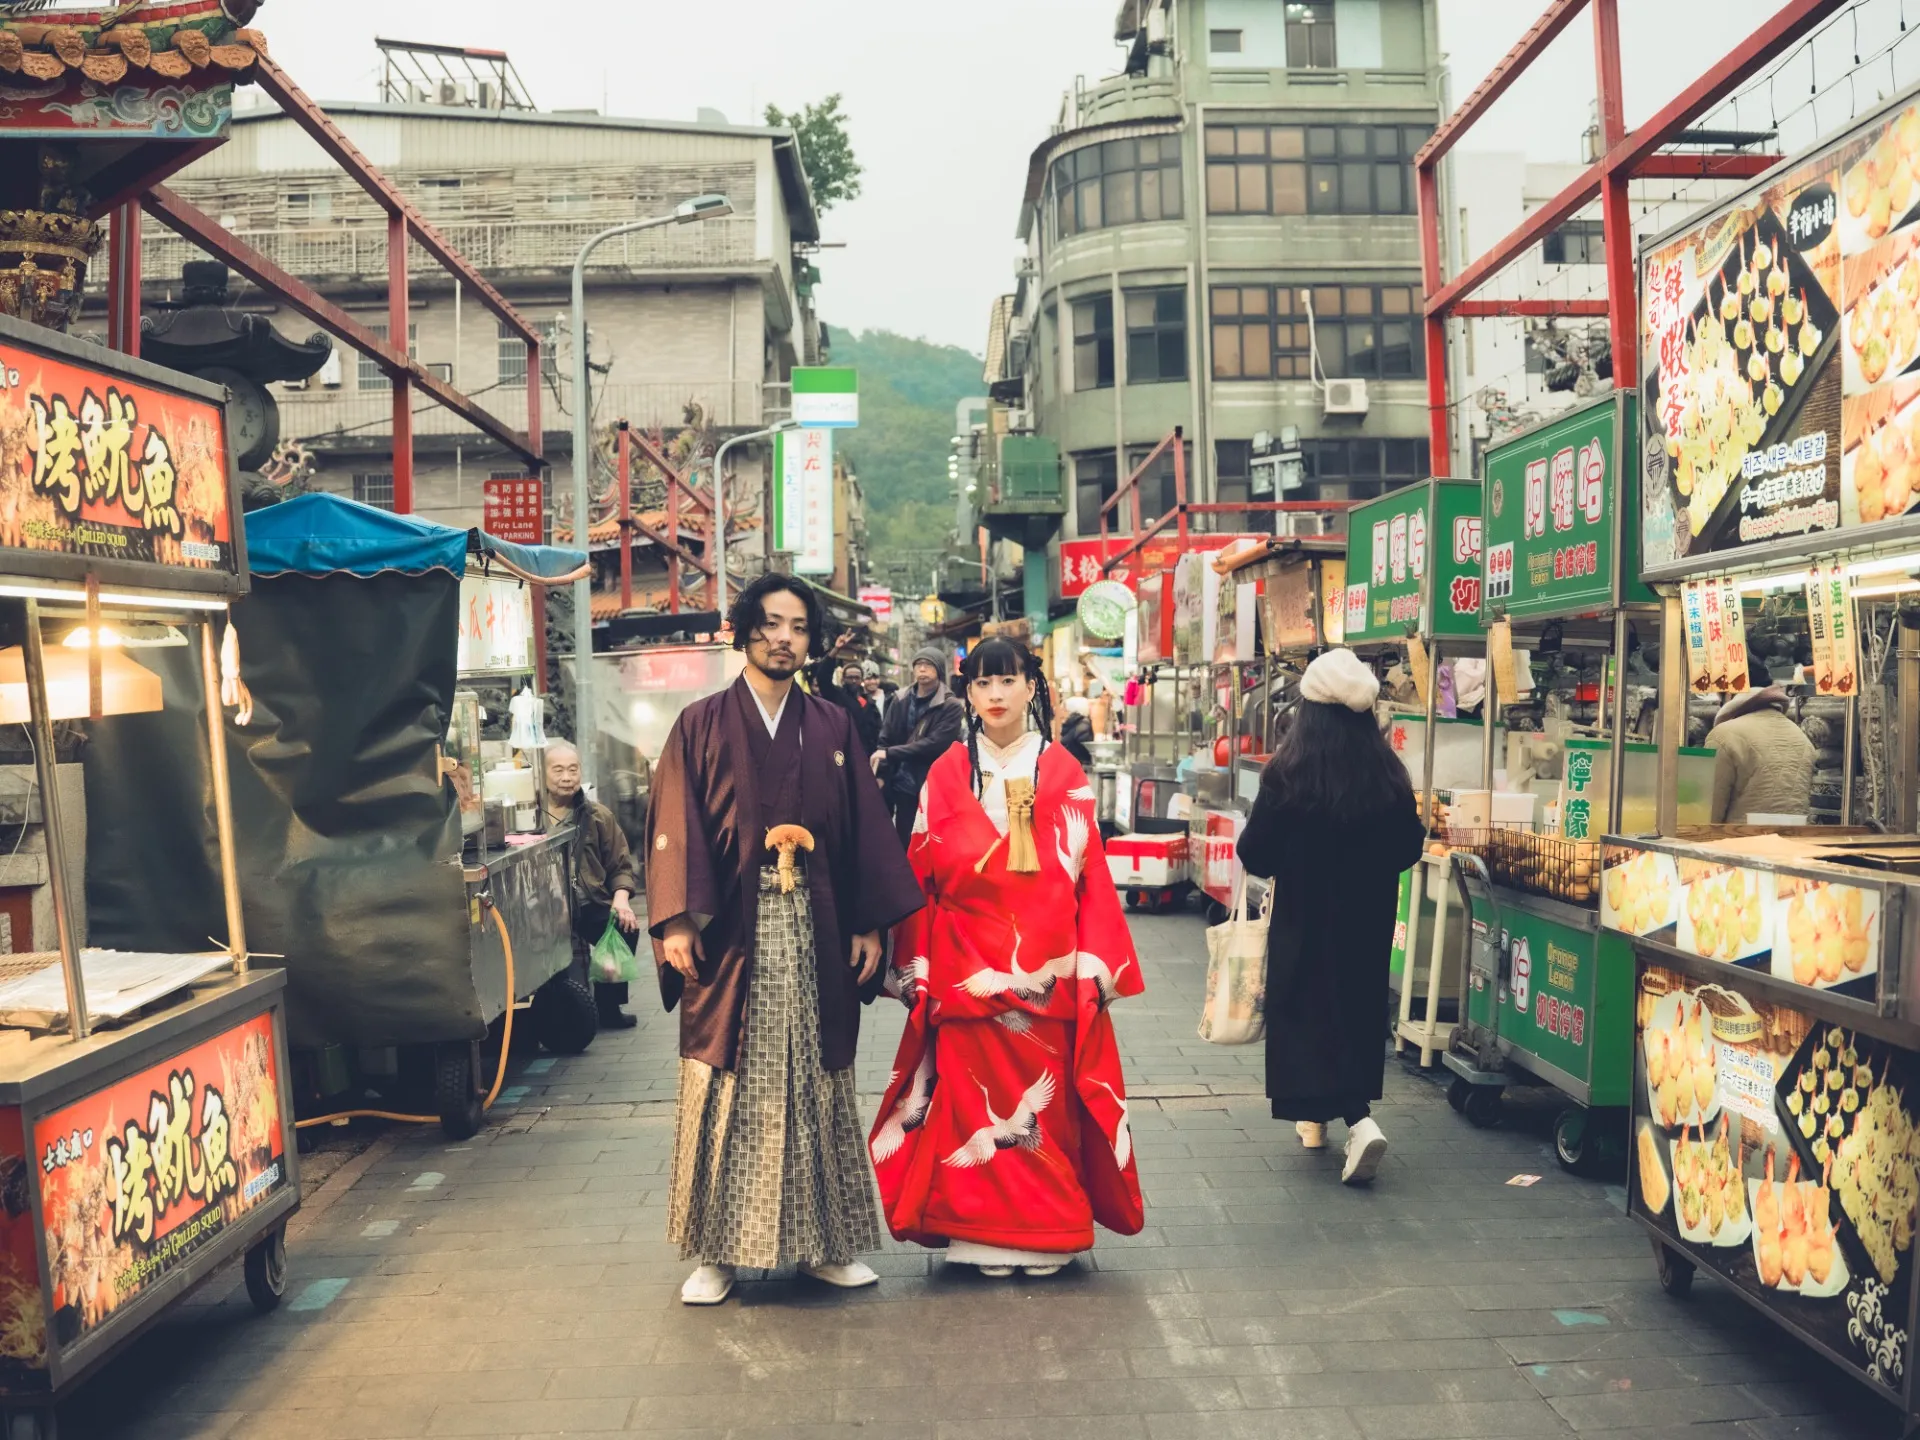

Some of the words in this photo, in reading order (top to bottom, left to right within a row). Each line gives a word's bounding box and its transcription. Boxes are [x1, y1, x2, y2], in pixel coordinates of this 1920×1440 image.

[1789, 193, 1834, 244] 幸福小站
[1649, 263, 1661, 329] 起司
[1660, 260, 1689, 438] 鮮蝦蛋
[28, 386, 180, 534] 烤魷魚
[489, 495, 537, 505] 止停車
[492, 521, 510, 529] Fire
[512, 521, 533, 529] Lane
[503, 532, 535, 540] PARKING
[1688, 593, 1704, 648] 芥末椒鹽
[1705, 591, 1722, 642] 辣味
[1724, 588, 1735, 609] 一份
[1728, 643, 1744, 663] 100
[1565, 752, 1592, 839] 檸檬
[109, 1069, 236, 1243] 烤魷魚
